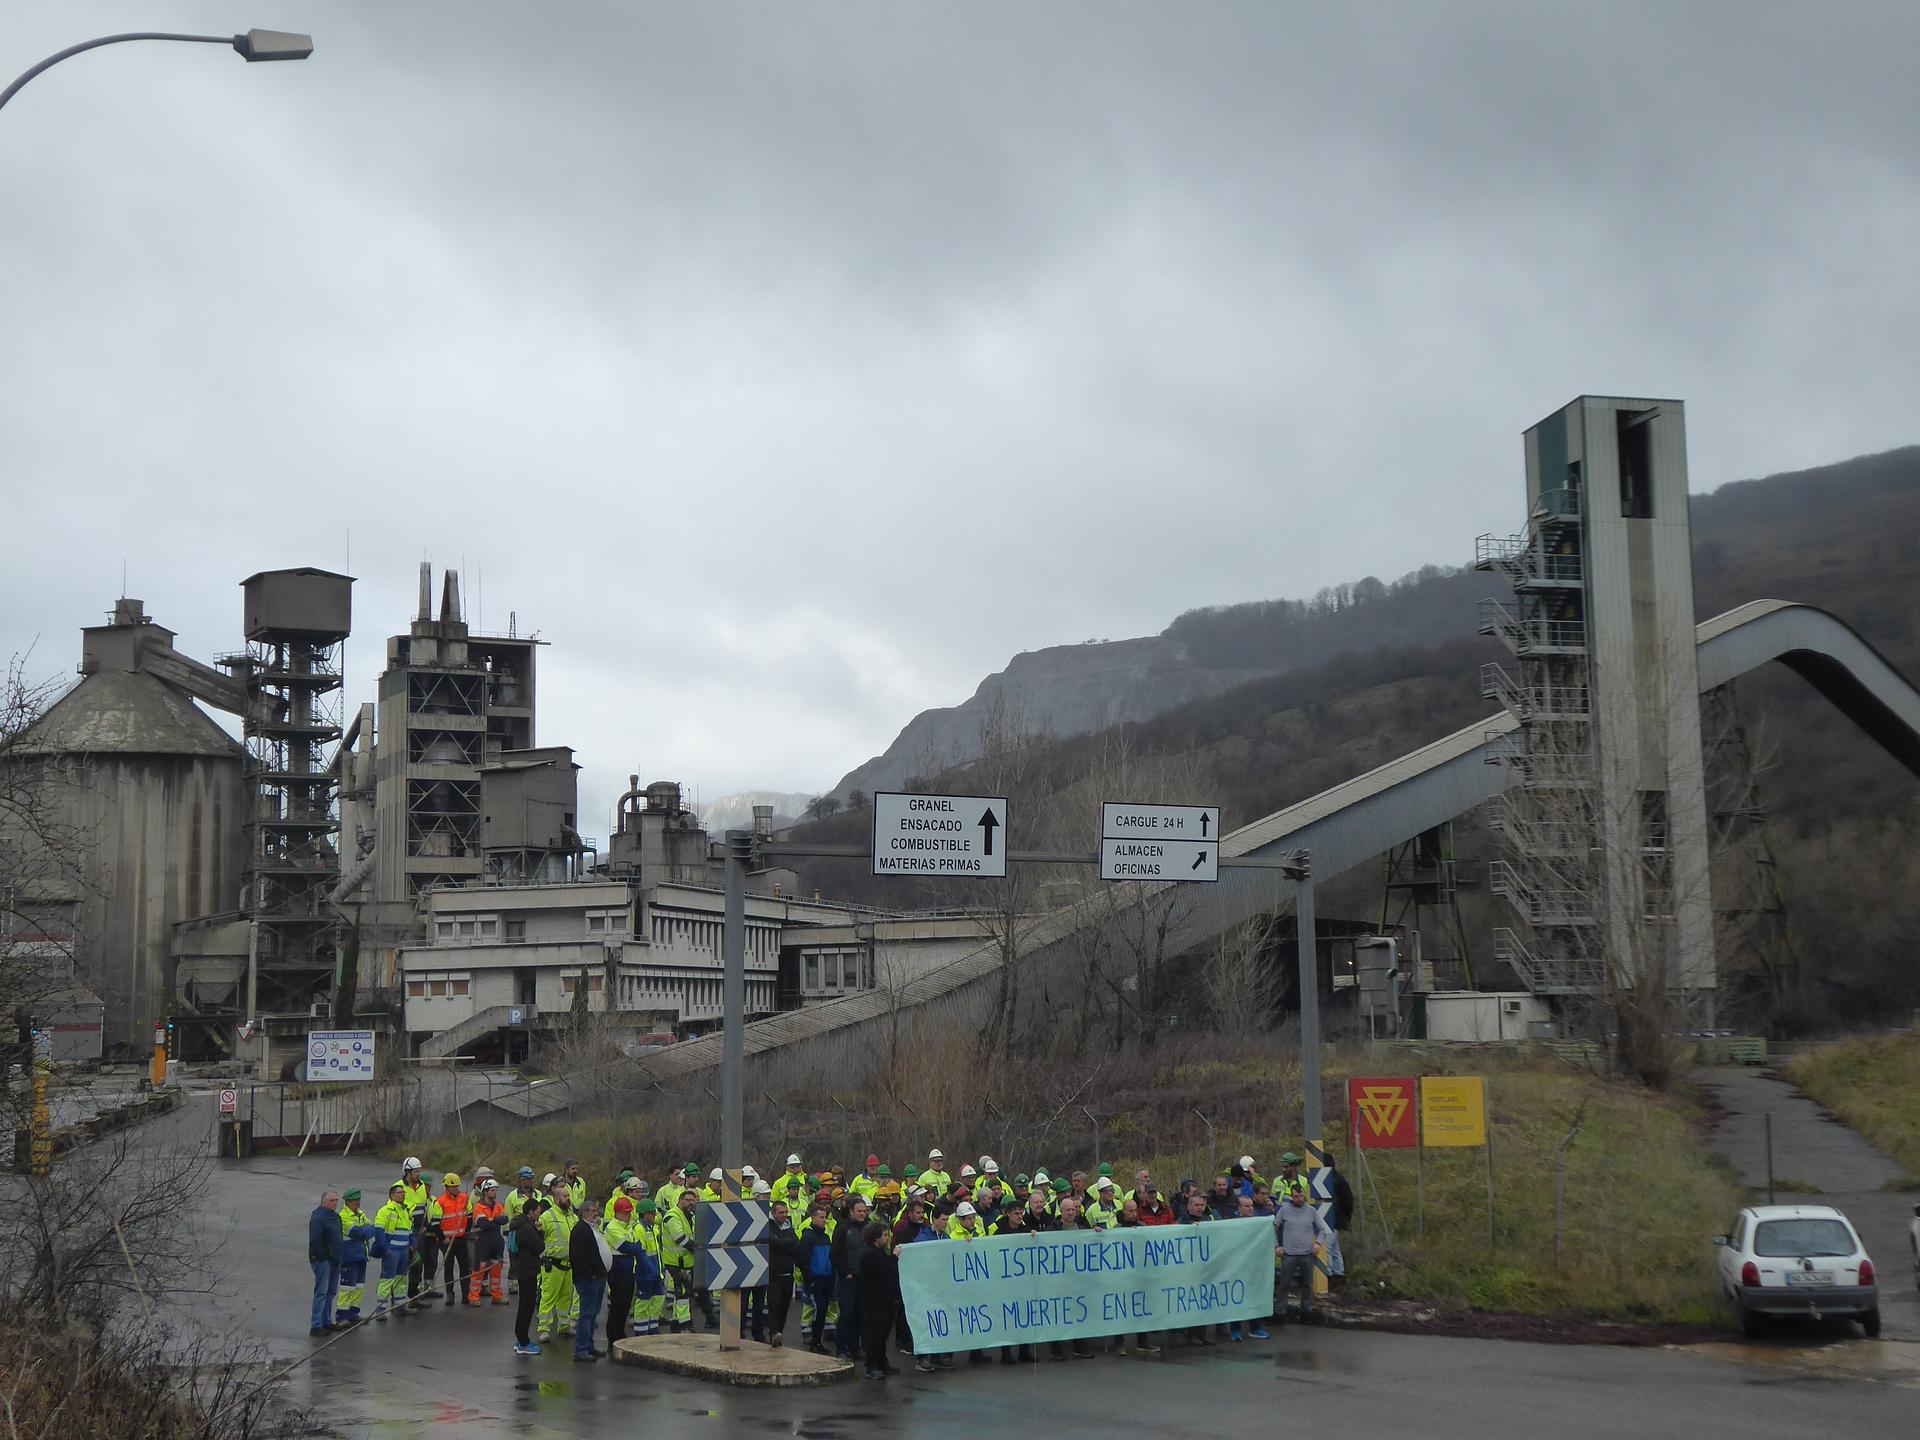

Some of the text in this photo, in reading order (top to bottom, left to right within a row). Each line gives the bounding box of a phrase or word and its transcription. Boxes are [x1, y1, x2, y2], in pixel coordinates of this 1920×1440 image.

[909, 799, 955, 812] GRANEL
[900, 818, 962, 832] ENSACADO
[1115, 815, 1184, 829] CARGUE 24 H
[891, 838, 970, 851] COMBUSTIBLE
[1114, 845, 1163, 857] ALMACEN
[879, 857, 981, 871] MATERIAS PRIMAS
[1114, 863, 1160, 875] OFICINAS
[512, 1010, 521, 1022] P
[951, 1235, 1210, 1283] LAN ISTRIPUEKIN AMAITU
[926, 1278, 1246, 1338] NO MAS MUERTES EN EL TRABAJO
